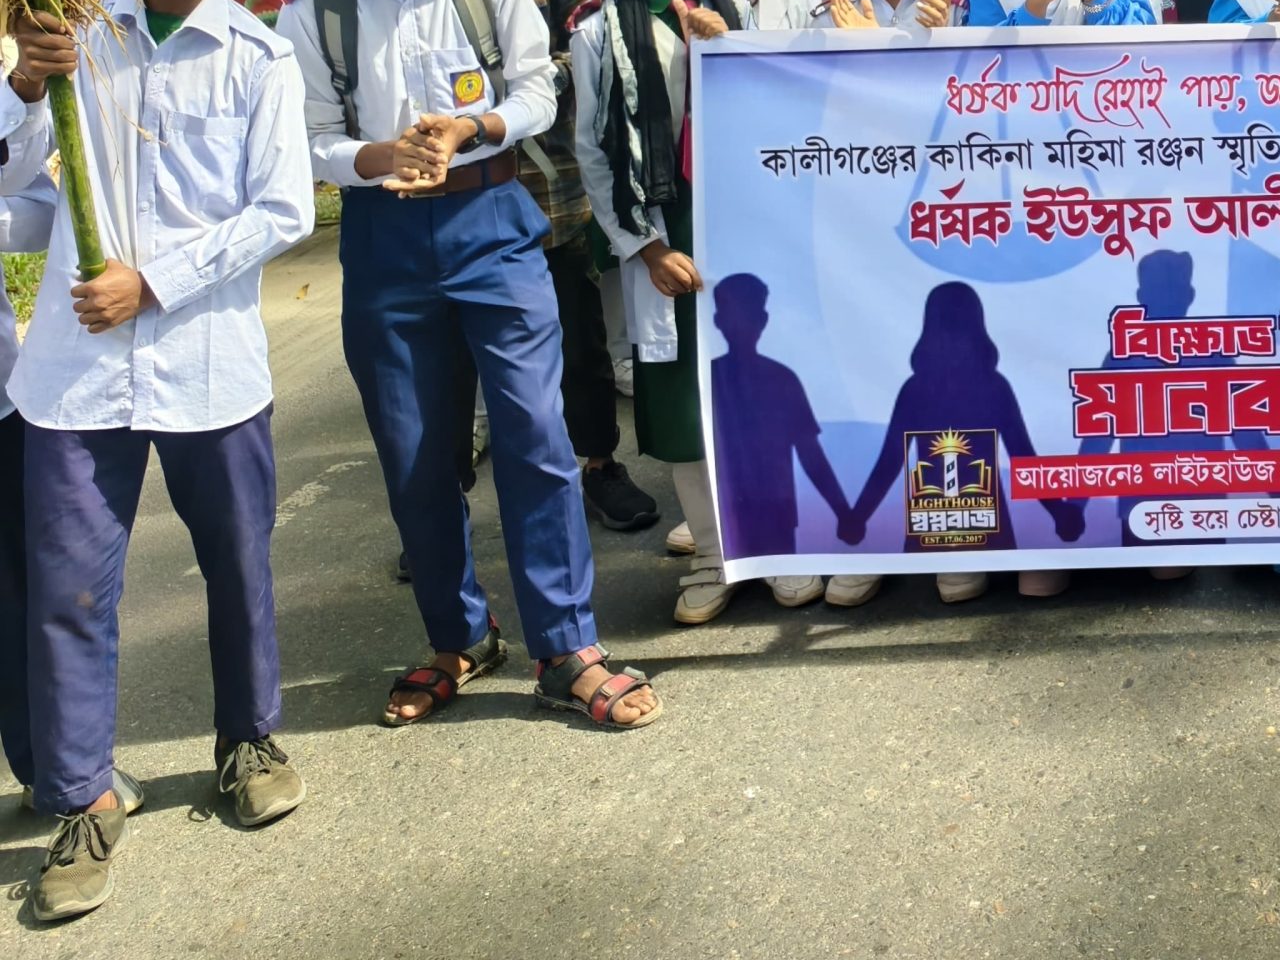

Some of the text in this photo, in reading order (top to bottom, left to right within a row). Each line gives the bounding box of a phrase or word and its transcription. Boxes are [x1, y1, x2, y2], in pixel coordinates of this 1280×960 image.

[946, 54, 1021, 116] ধর্ষক
[1025, 53, 1131, 124] যদি
[1093, 58, 1173, 130] রেহাই
[1179, 73, 1248, 114] পায়,
[760, 135, 917, 179] কালীগঞ্জের
[925, 131, 1034, 172] কাকিনা
[1043, 128, 1127, 172] মহিমা
[1134, 136, 1206, 171] রঞ্জন
[909, 178, 1013, 247] ধর্ষক
[1022, 184, 1173, 261] ইউসুফ
[1109, 304, 1276, 364] বিক্ষোভ
[1149, 453, 1276, 487] লাইটহাউজ
[910, 496, 995, 509] LIGHTHOUSE
[1143, 502, 1184, 537] সৃষ্টি
[1190, 508, 1230, 533] হয়ে
[910, 509, 997, 532] স্বপ্নবাজ
[924, 534, 983, 544] EST. 17.06.2017
